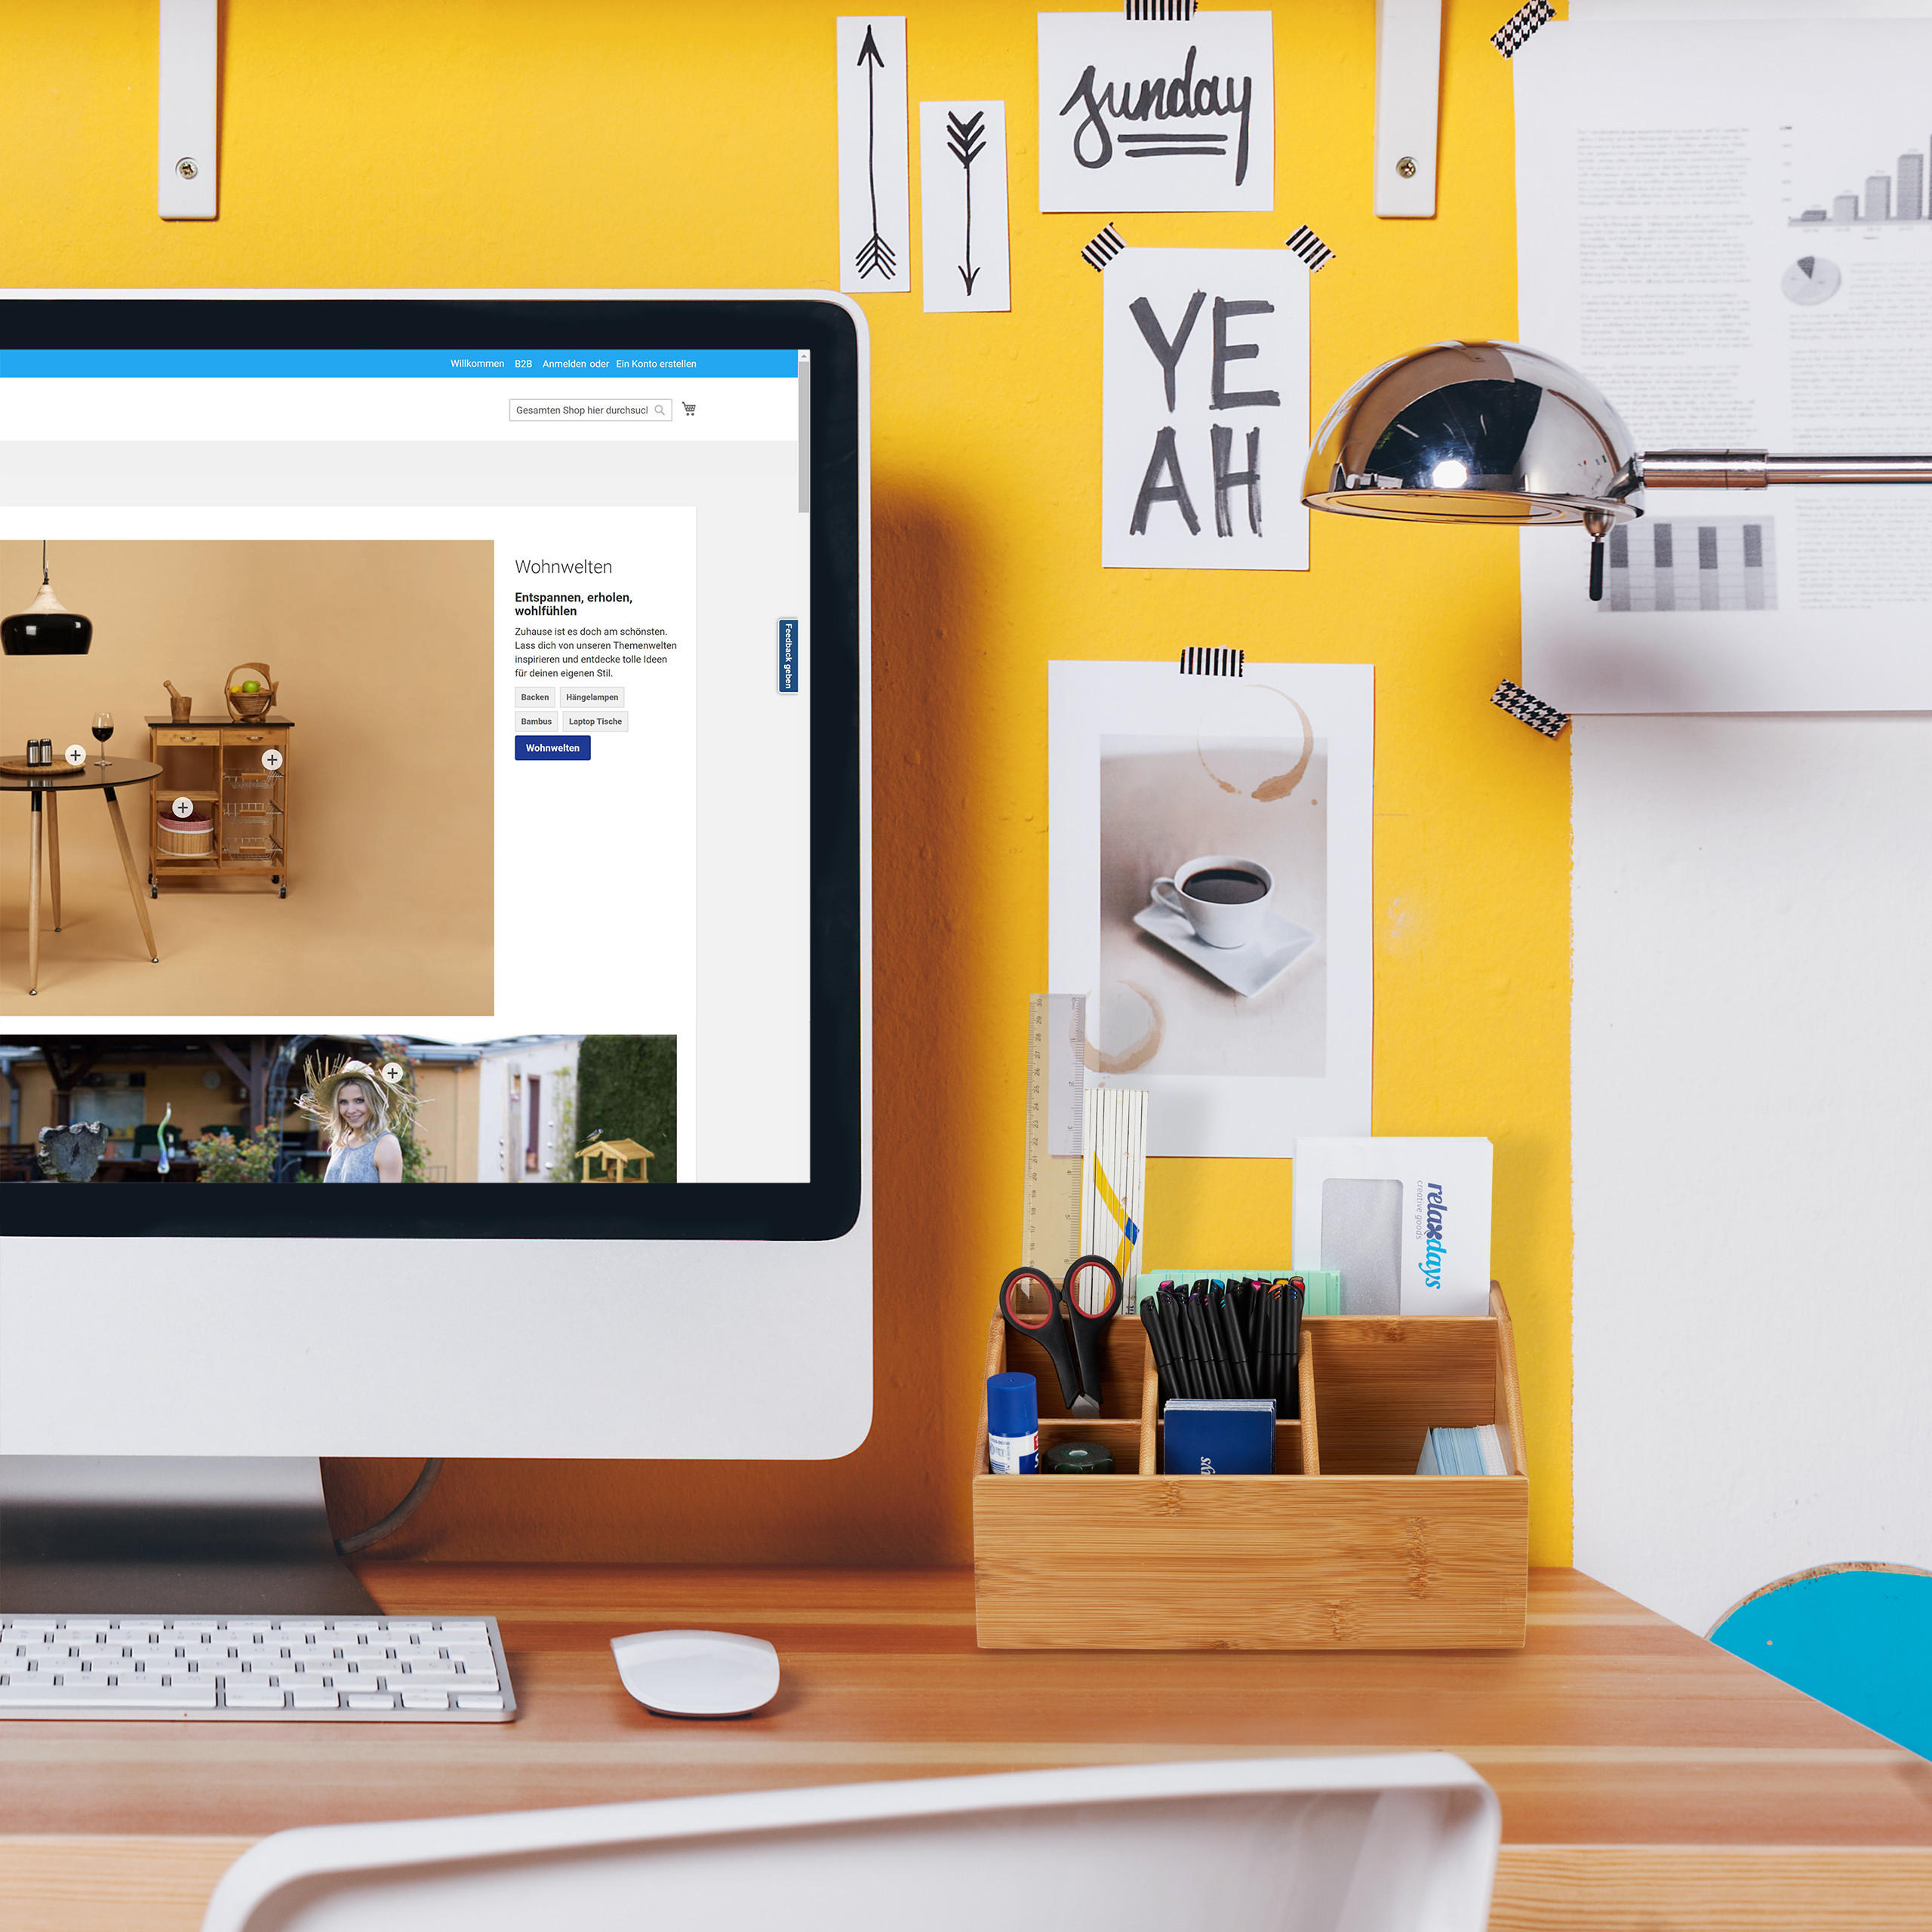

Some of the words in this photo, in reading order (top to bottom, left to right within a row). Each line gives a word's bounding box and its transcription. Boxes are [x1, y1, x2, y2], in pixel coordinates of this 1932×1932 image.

[451, 359, 504, 368] Willkommen
[515, 360, 532, 368] B2B
[543, 359, 586, 368] Anmelden
[590, 359, 609, 368] oder
[617, 359, 629, 368] Ein
[632, 359, 657, 368] Konto
[660, 359, 697, 368] erstellen
[516, 406, 560, 414] Gesamten
[563, 406, 585, 416] Shop
[588, 406, 604, 414] hier
[515, 559, 612, 574] Wohnwelten
[515, 592, 584, 605] Entspannen,
[587, 592, 632, 604] erholen,
[515, 605, 577, 616] wohlfühlen
[515, 627, 552, 636] Zuhause
[555, 627, 565, 636] ist
[580, 627, 601, 636] doch
[620, 627, 668, 636] schönsten.
[515, 641, 535, 650] Lass
[538, 641, 555, 650] dich
[614, 641, 677, 650] Themenwelten
[515, 654, 559, 665] inspirieren
[562, 655, 579, 663] und
[581, 655, 620, 663] entdecke
[623, 655, 641, 663] tolle
[644, 655, 667, 663] Ideen
[515, 669, 527, 677] für
[530, 669, 558, 677] deinen
[561, 669, 594, 679] eigenen
[597, 669, 613, 677] Stil.
[783, 664, 792, 688] geben
[521, 693, 549, 701] Backen
[566, 693, 619, 703] Hängelampen
[569, 718, 595, 727] Laptop
[526, 743, 580, 752] Wohnwelten
[1036, 1016, 1042, 1025] 29
[1035, 1033, 1041, 1041] 28
[1035, 1051, 1041, 1060] 27
[1034, 1068, 1040, 1077] 26
[1034, 1085, 1040, 1094] 25
[1033, 1103, 1039, 1111] 24
[1414, 1215, 1423, 1240] goods
